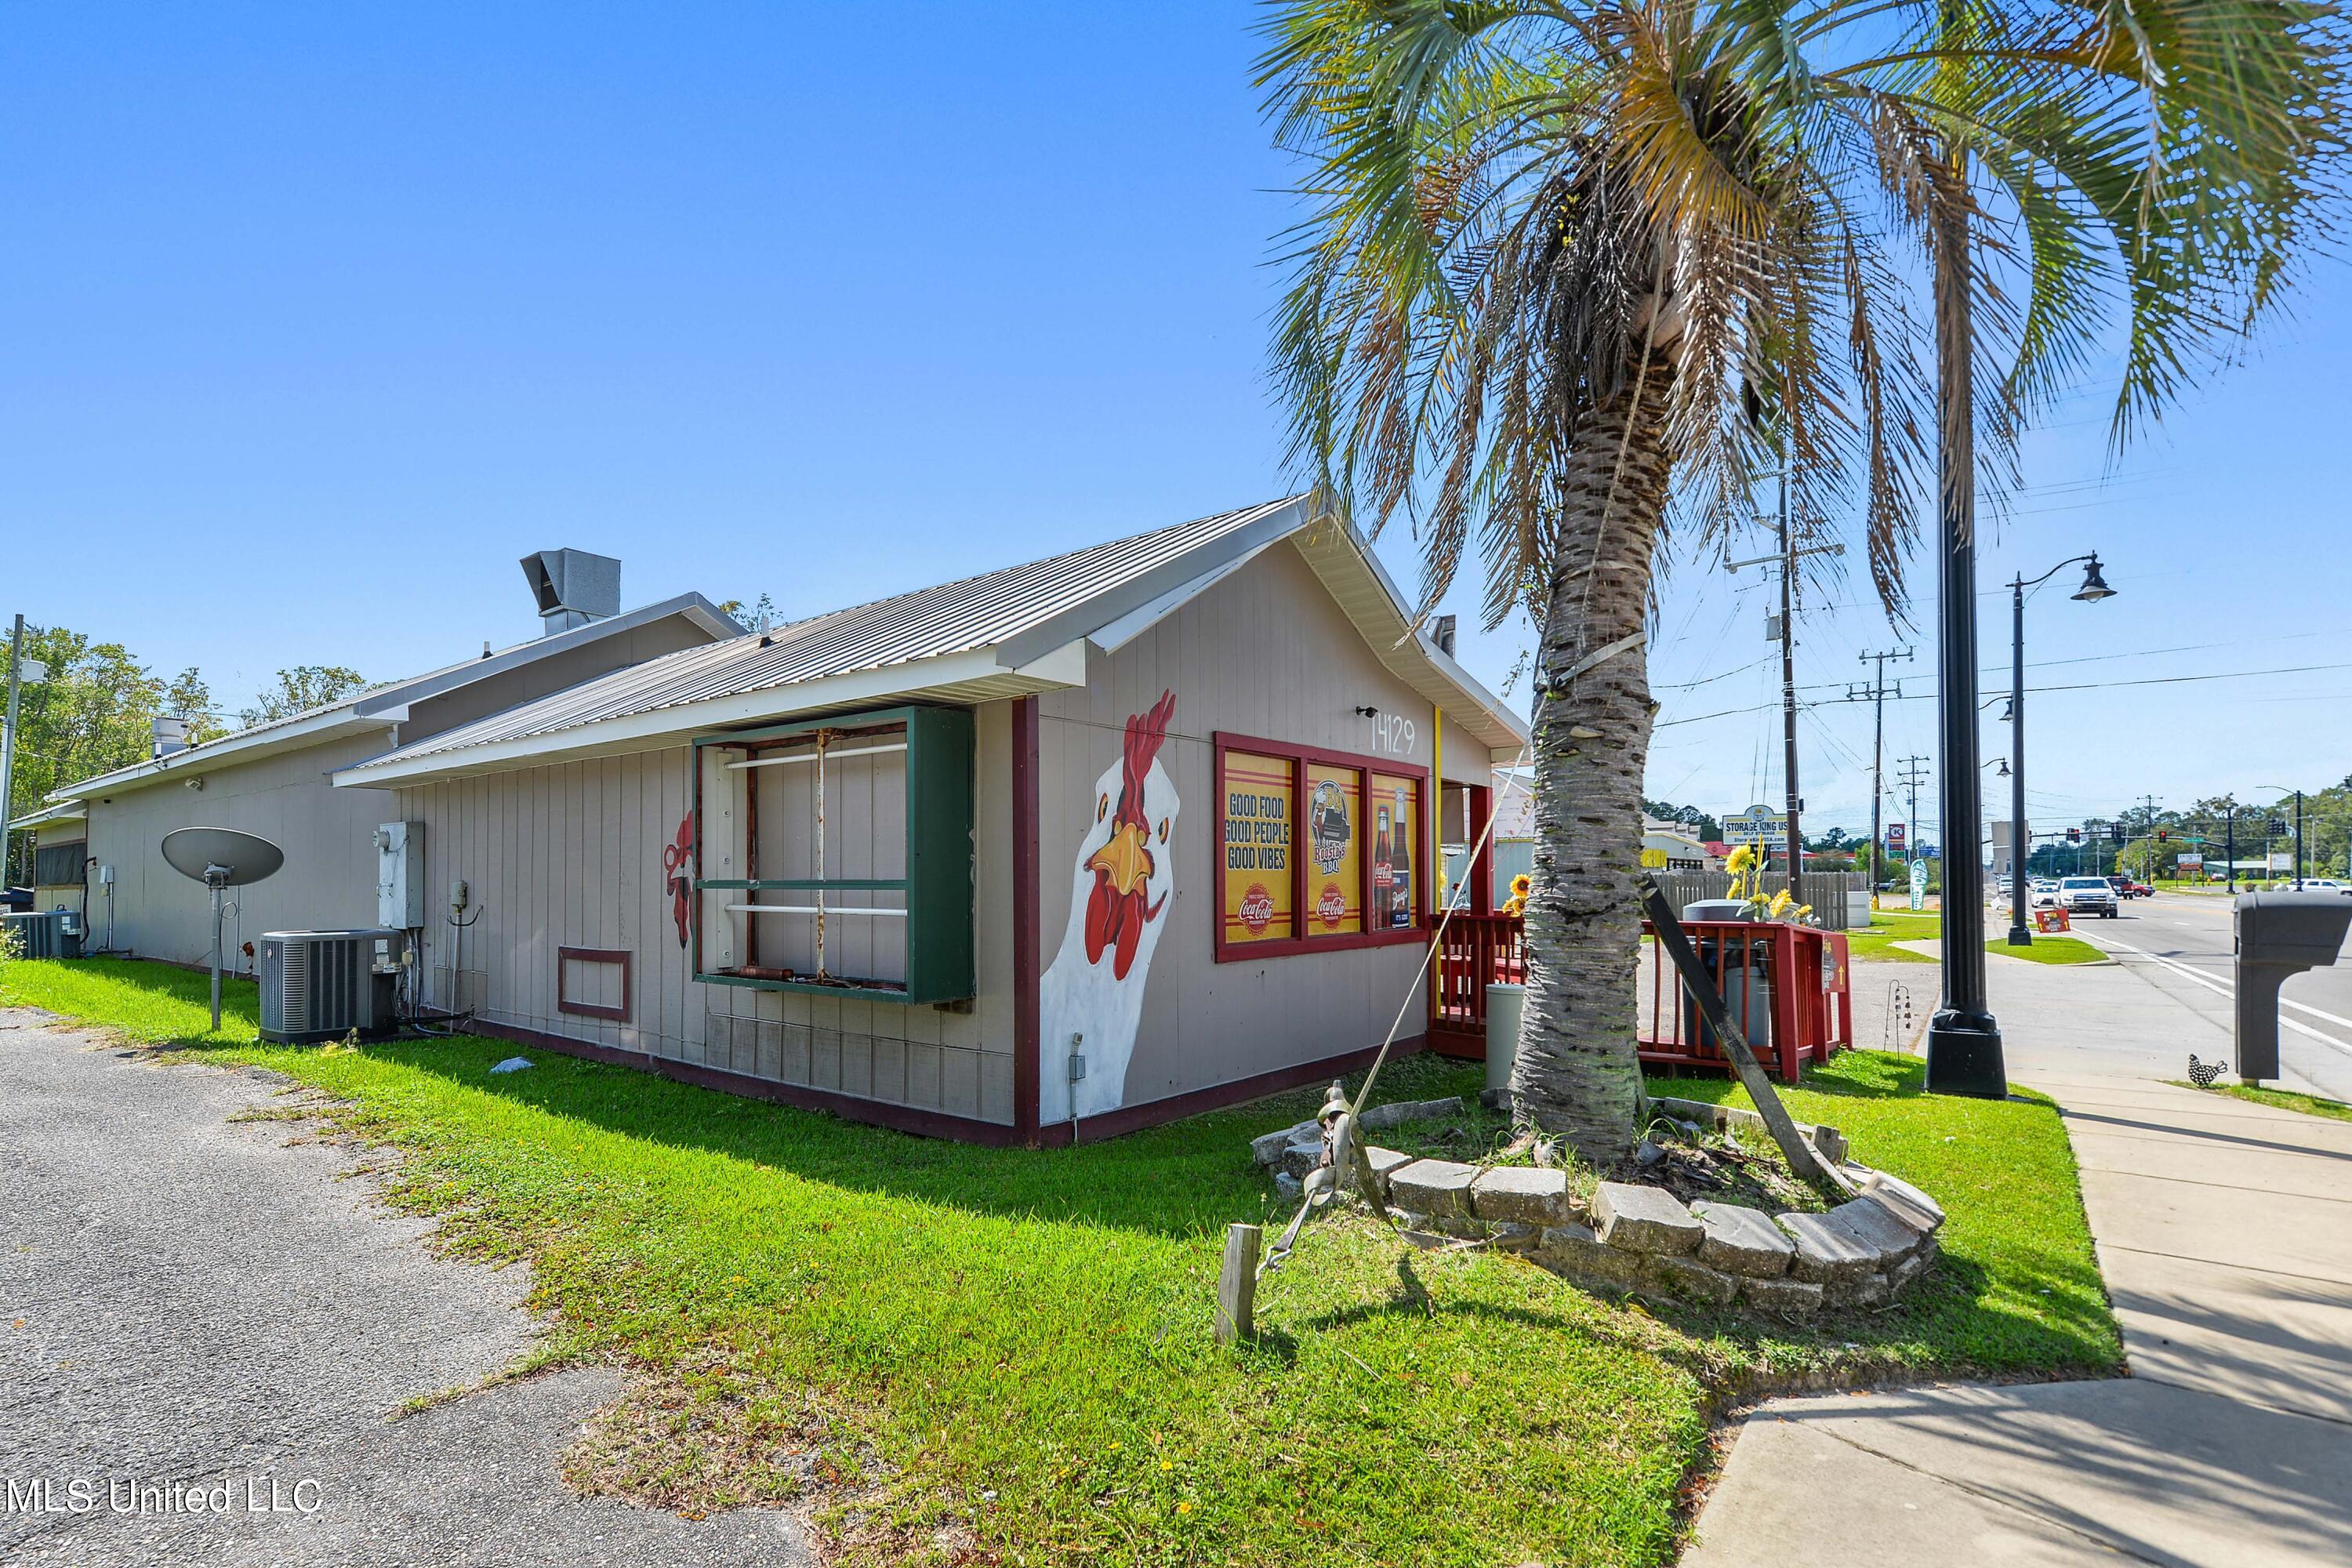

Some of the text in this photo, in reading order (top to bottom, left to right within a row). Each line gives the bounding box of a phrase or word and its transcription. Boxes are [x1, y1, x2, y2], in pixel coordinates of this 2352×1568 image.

[1372, 713, 1415, 754] 14129
[1229, 793, 1284, 820] GOOD FOOD
[1225, 819, 1290, 845] GOOD PEOPLE
[1726, 821, 1788, 832] STORAGE KING US
[1228, 846, 1286, 870] GOOD VIBES
[1322, 860, 1339, 875] BBQ
